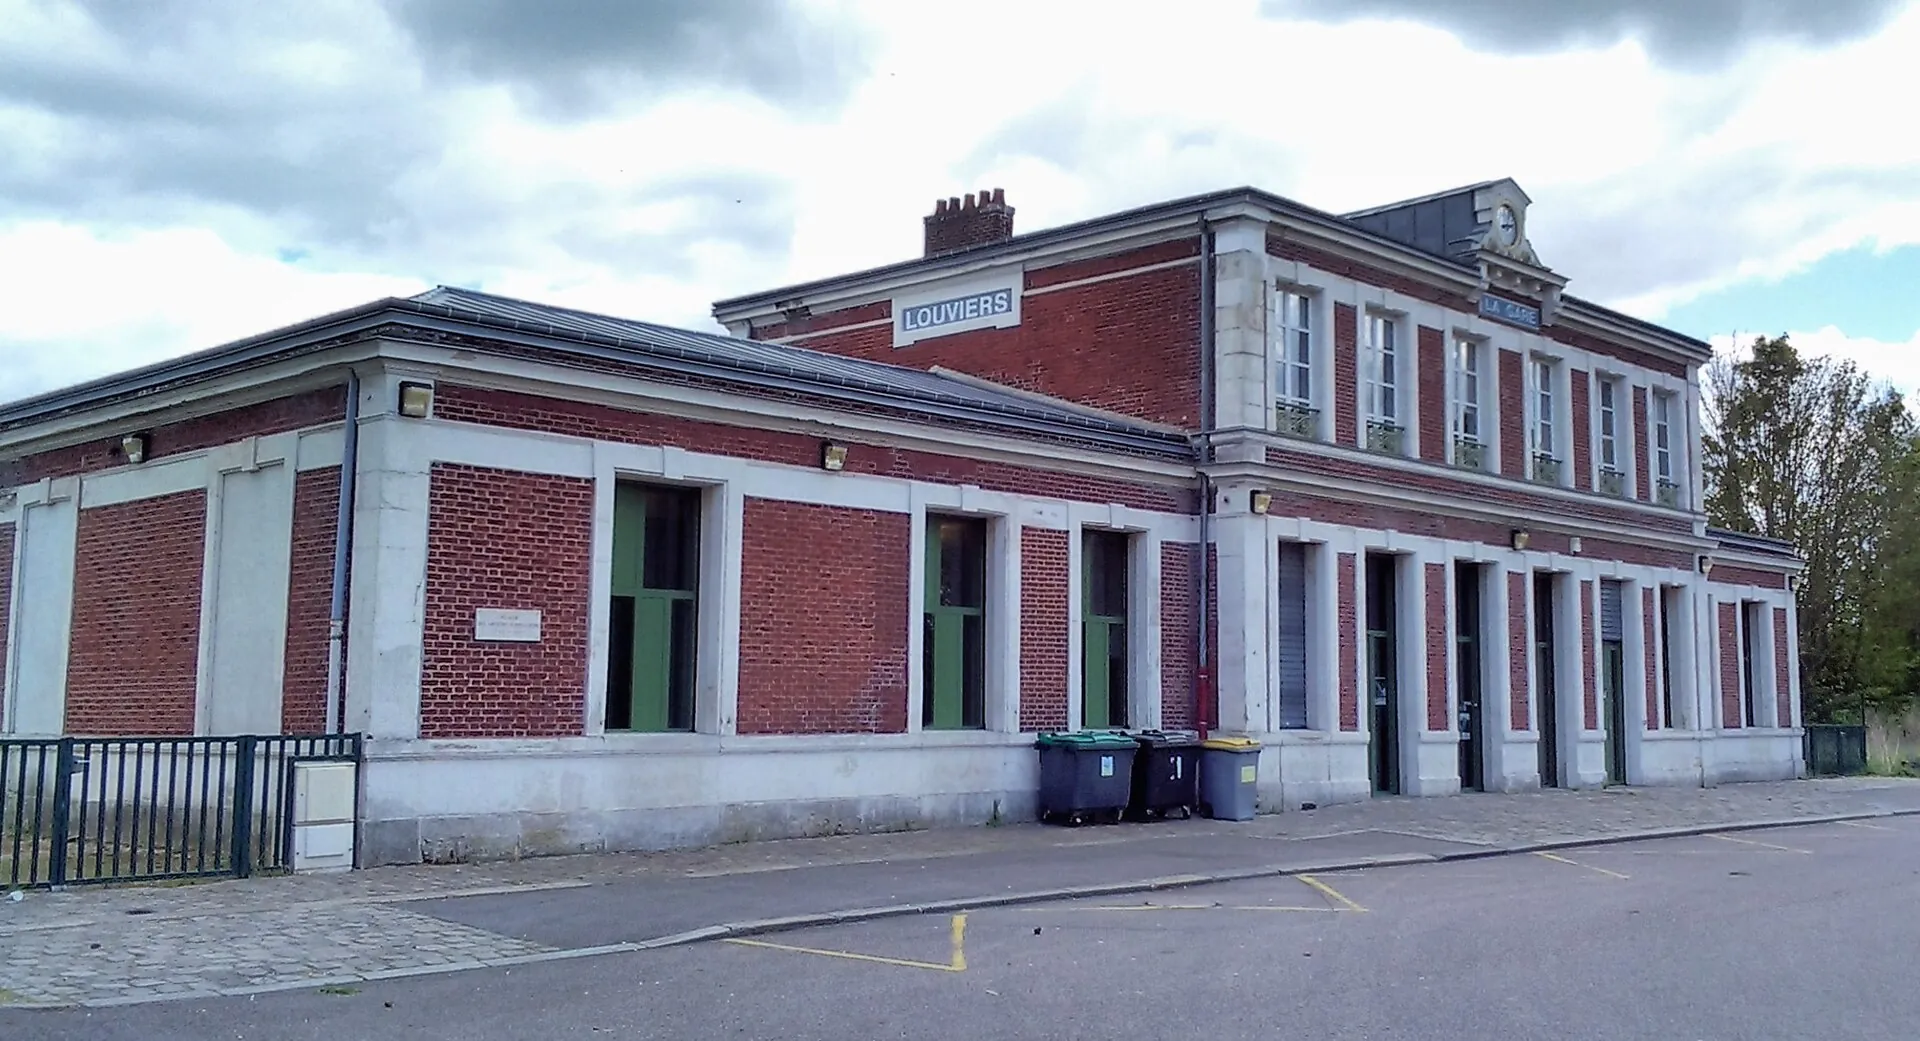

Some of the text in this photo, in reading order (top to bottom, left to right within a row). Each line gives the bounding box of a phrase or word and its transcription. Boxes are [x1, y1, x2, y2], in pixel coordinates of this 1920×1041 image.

[905, 292, 1008, 330] LOUVIERS
[1485, 297, 1537, 324] LA GARE
